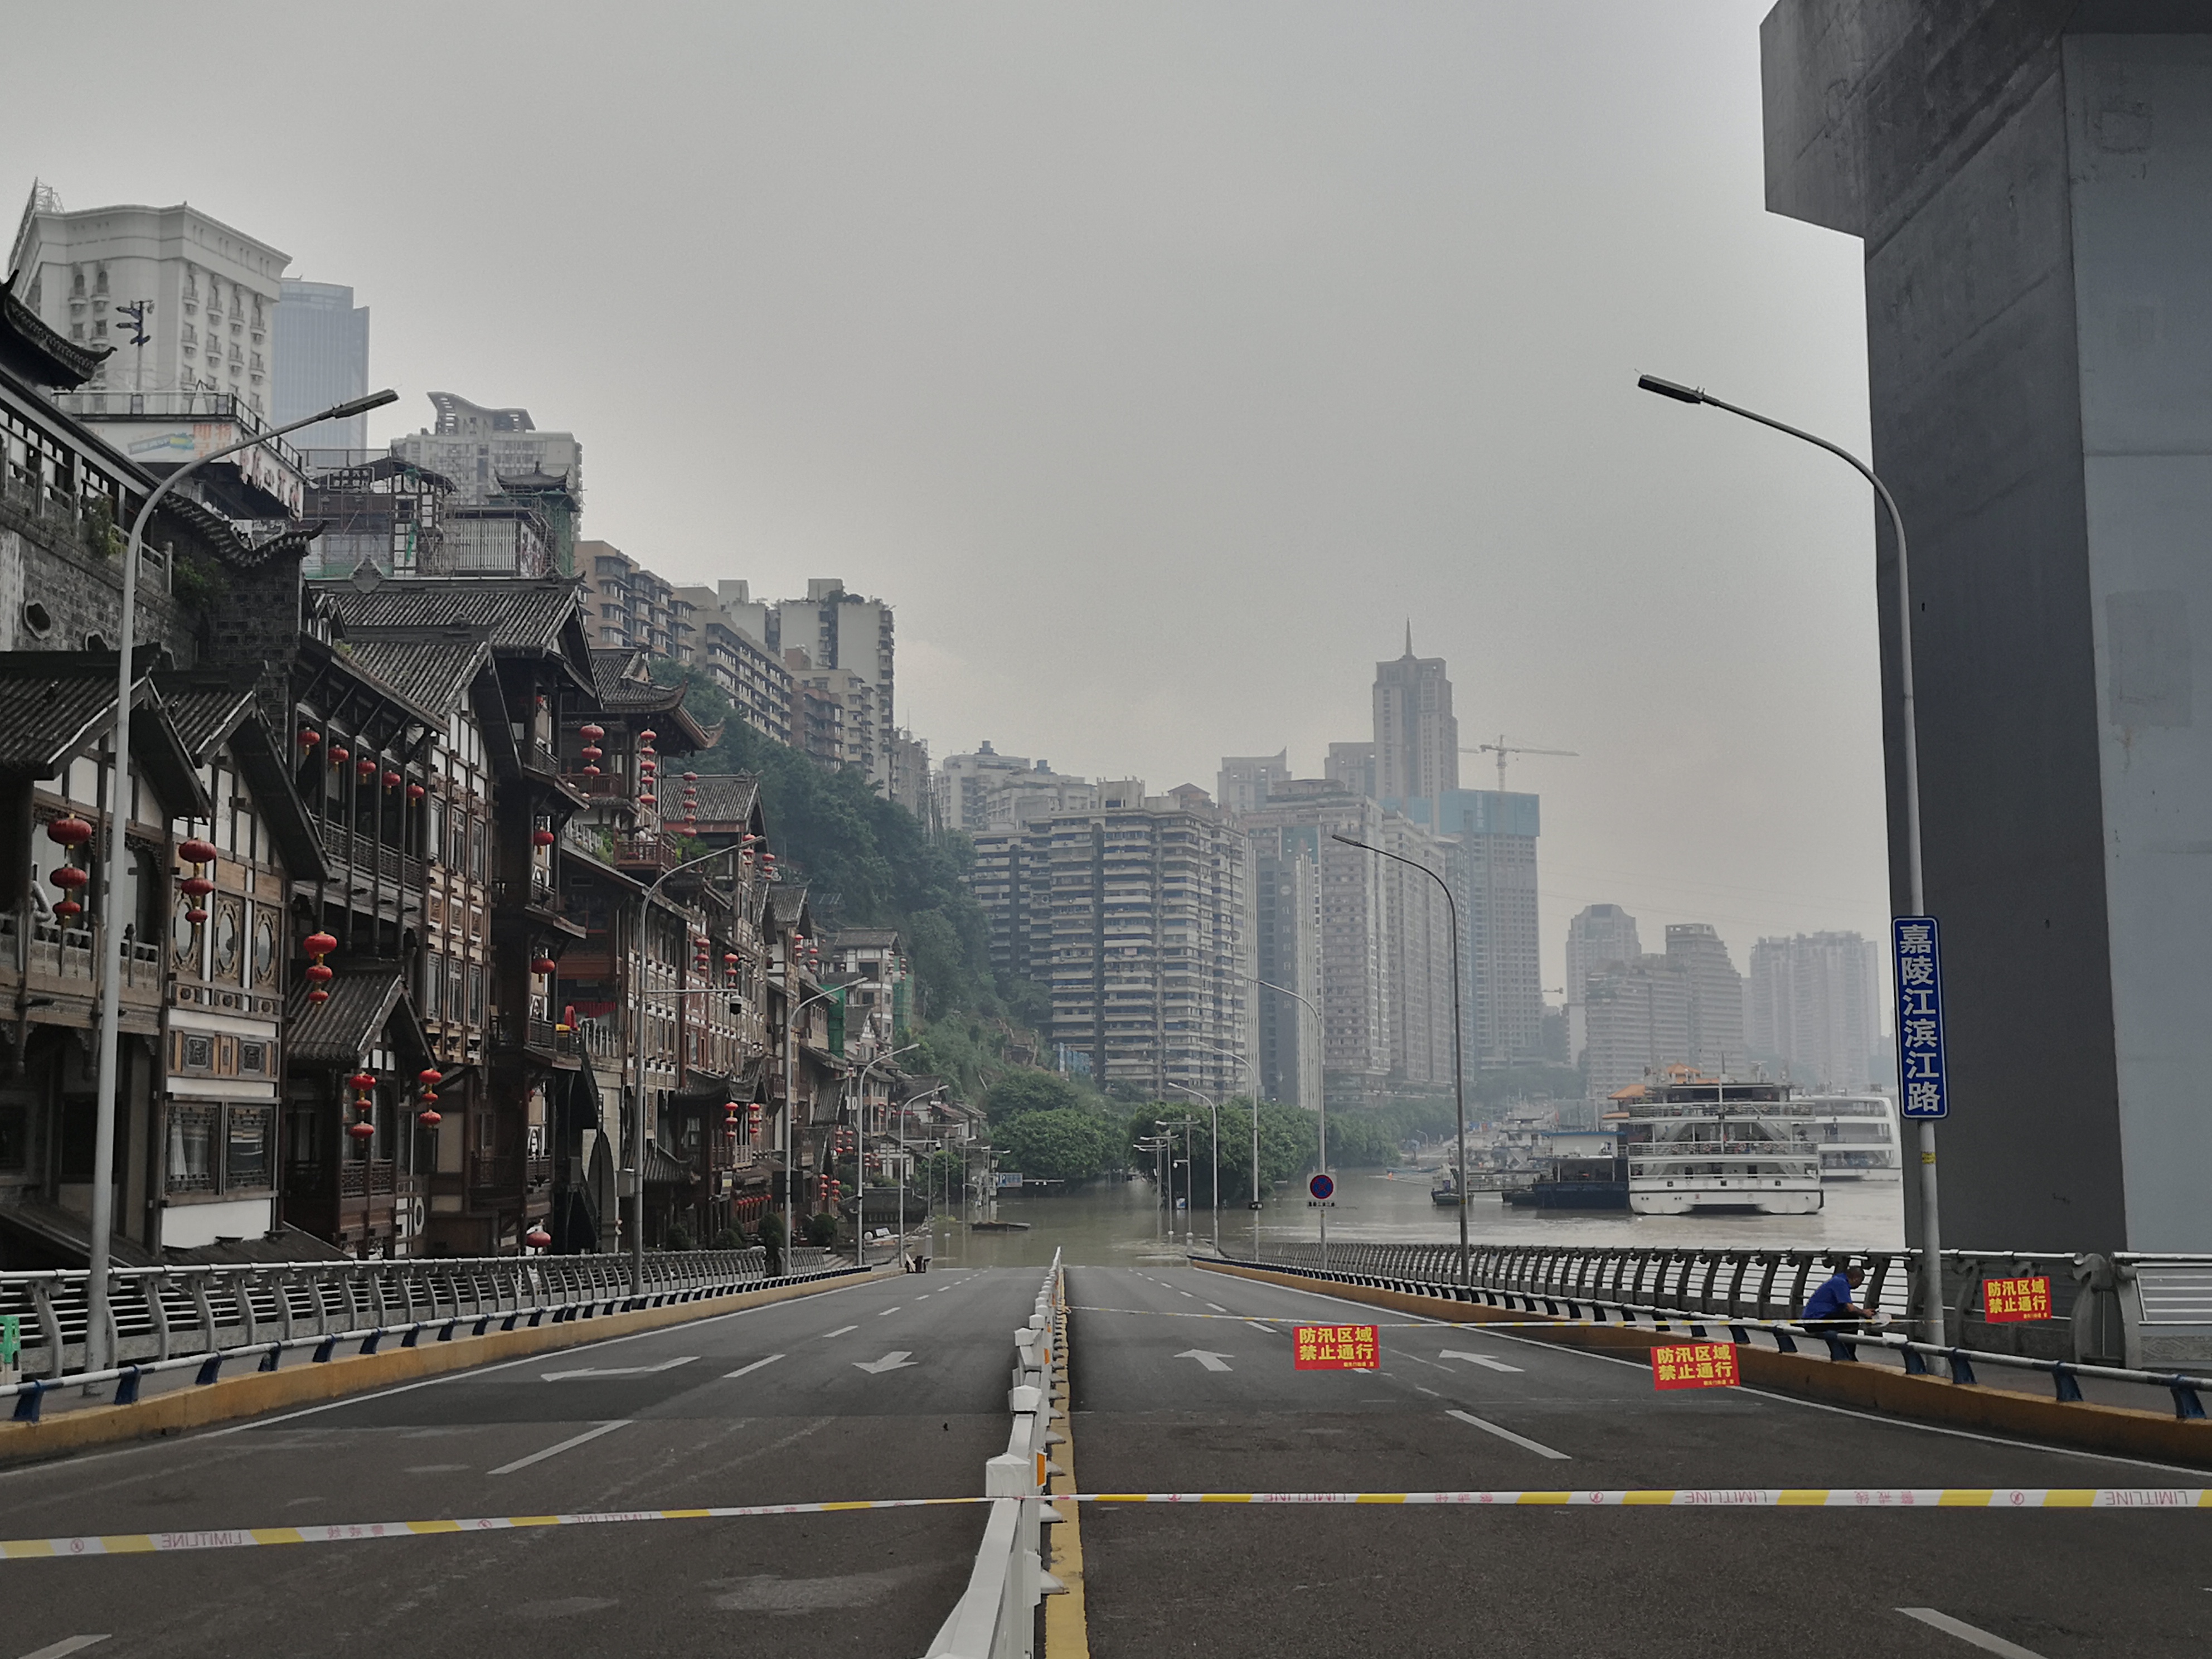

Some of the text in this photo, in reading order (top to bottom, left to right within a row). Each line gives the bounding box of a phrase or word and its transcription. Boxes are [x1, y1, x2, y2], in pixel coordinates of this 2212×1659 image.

[1899, 924, 1941, 1112] 嘉陵江滨江路
[1987, 1279, 2046, 1297] 防汛区域
[1988, 1296, 2046, 1313] 禁止通行
[1299, 1327, 1373, 1344] 防汛区域
[1299, 1343, 1374, 1361] 禁止通行
[1657, 1345, 1731, 1364] 防汛区域
[1658, 1361, 1733, 1381] 禁止通行
[1683, 1491, 1767, 1504] LIMITLINE
[2104, 1491, 2188, 1505] LIMITLINE
